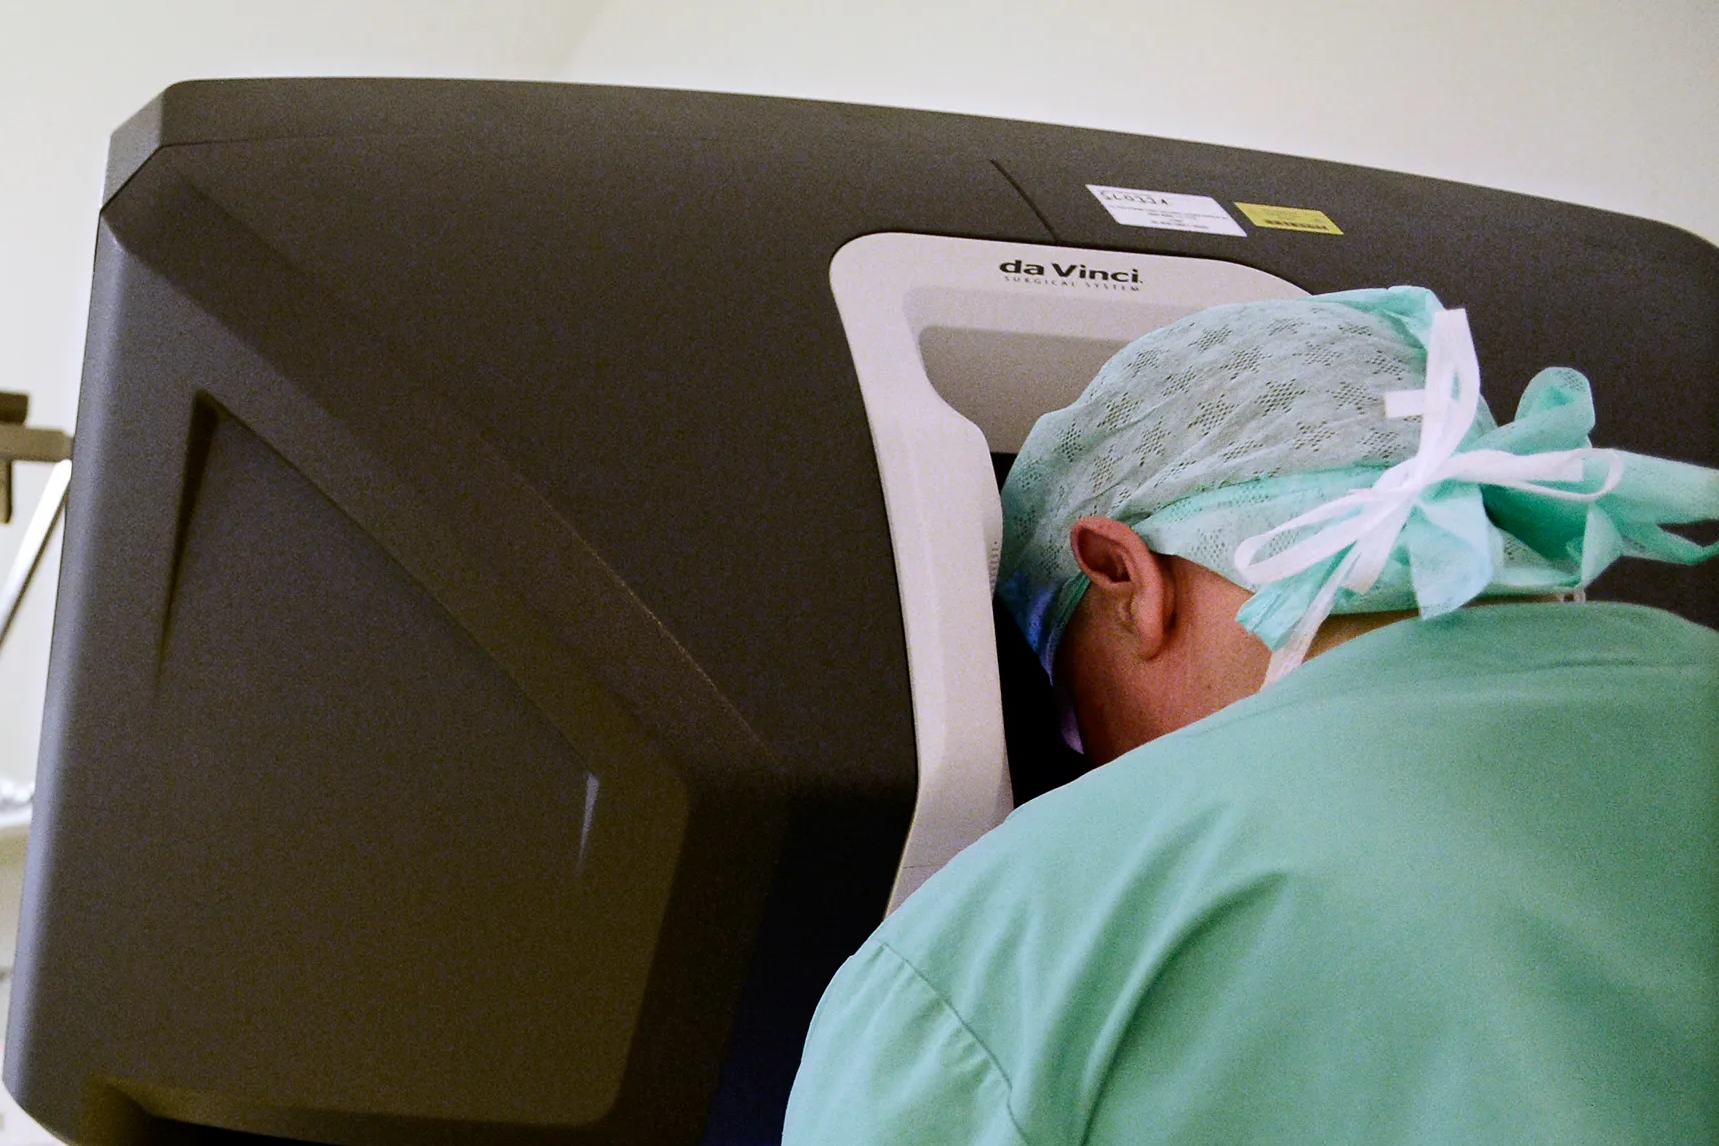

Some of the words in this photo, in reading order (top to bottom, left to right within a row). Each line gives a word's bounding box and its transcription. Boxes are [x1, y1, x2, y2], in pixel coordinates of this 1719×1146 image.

[999, 259, 1045, 276] da
[1051, 262, 1140, 284] Vinci
[1004, 276, 1078, 288] SURGICAL
[1085, 282, 1140, 292] SYSTEM
